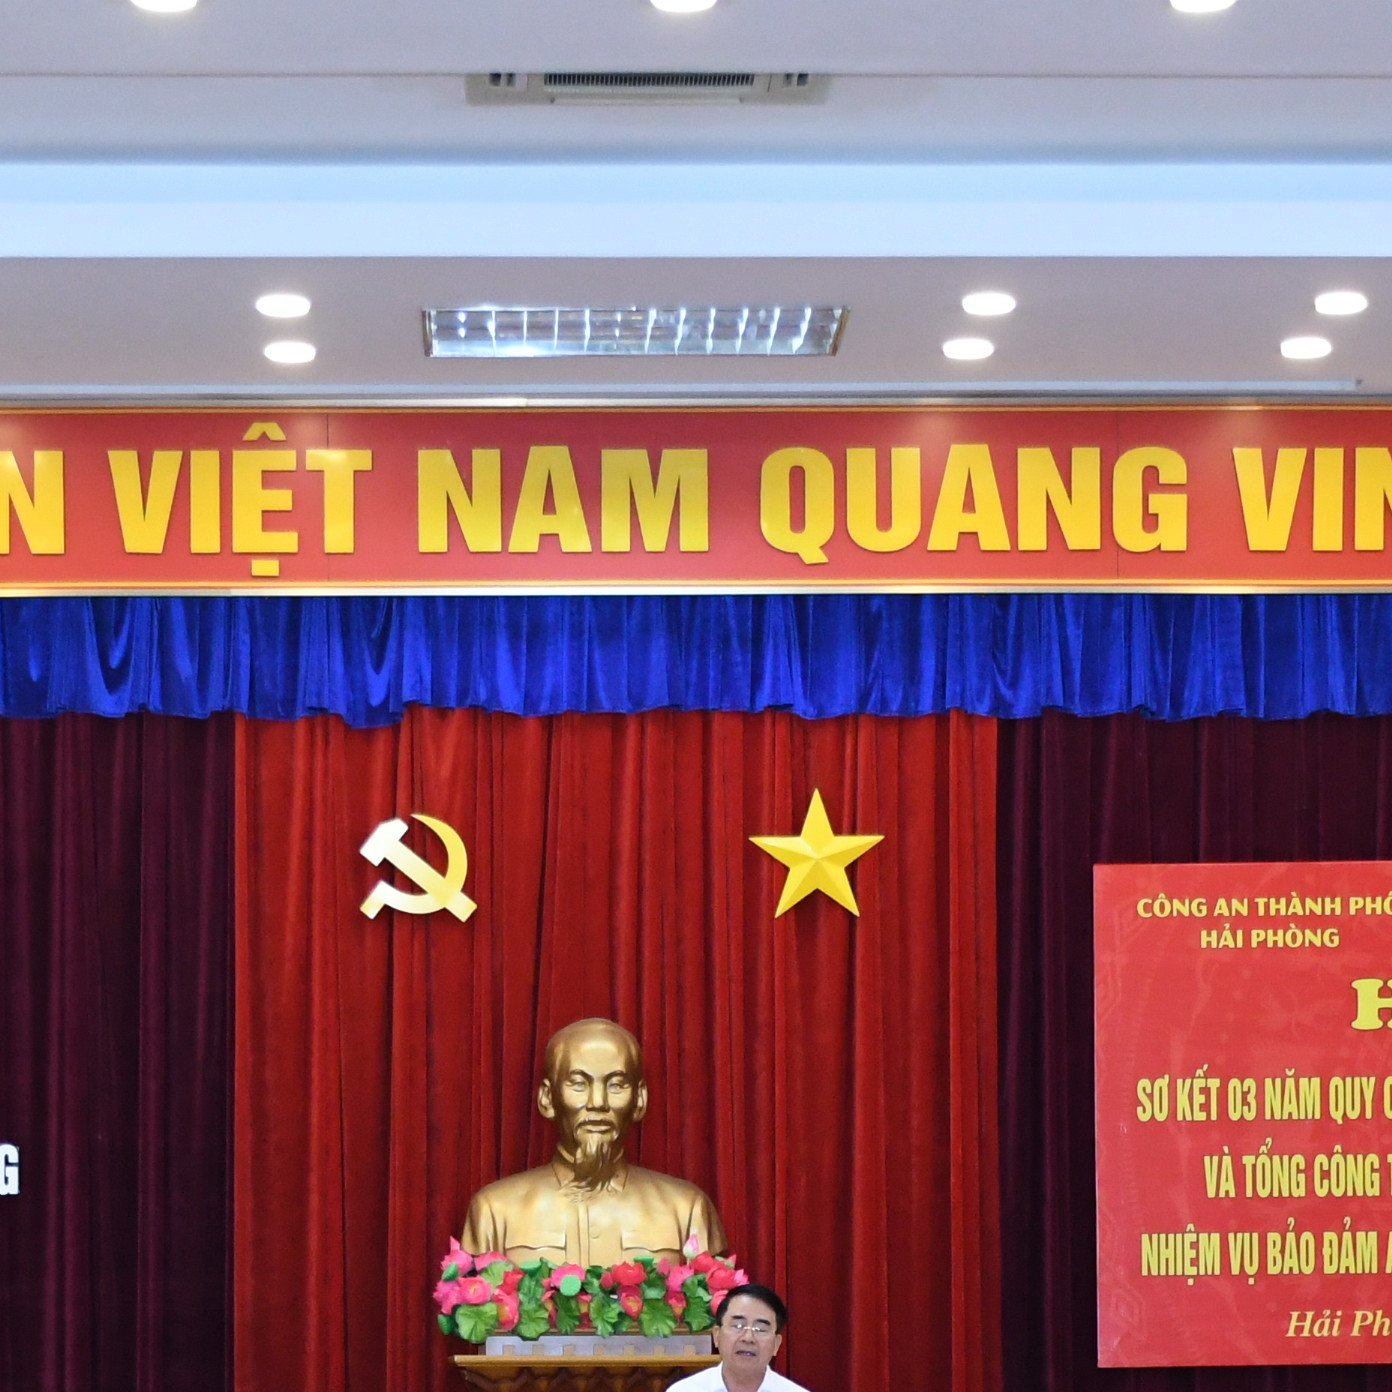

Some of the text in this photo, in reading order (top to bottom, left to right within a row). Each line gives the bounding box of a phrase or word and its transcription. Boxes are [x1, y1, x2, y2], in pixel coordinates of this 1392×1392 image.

[108, 423, 372, 576] VIỆT
[418, 446, 709, 552] NAM
[760, 444, 1187, 564] QUANG
[1137, 893, 1207, 917] CÔNG
[1214, 898, 1248, 916] AN
[1255, 892, 1341, 916] THÀNH
[1201, 923, 1339, 948] HẢI PHÒNG
[1137, 1075, 1169, 1121] SƠ
[1177, 1064, 1220, 1120] KẾT
[1228, 1078, 1256, 1120] 03
[1265, 1069, 1320, 1119] NĂM
[1329, 1077, 1375, 1124] QUY
[1204, 1146, 1235, 1198] VÀ
[1242, 1138, 1305, 1197] TỔNG
[1314, 1145, 1380, 1197] CÔNG
[1142, 1224, 1220, 1285] NHIỆM
[1228, 1232, 1258, 1284] VỤ
[1267, 1217, 1315, 1274] BẢO
[1323, 1217, 1377, 1274] ĐẢM
[1286, 1310, 1342, 1336] Hải
